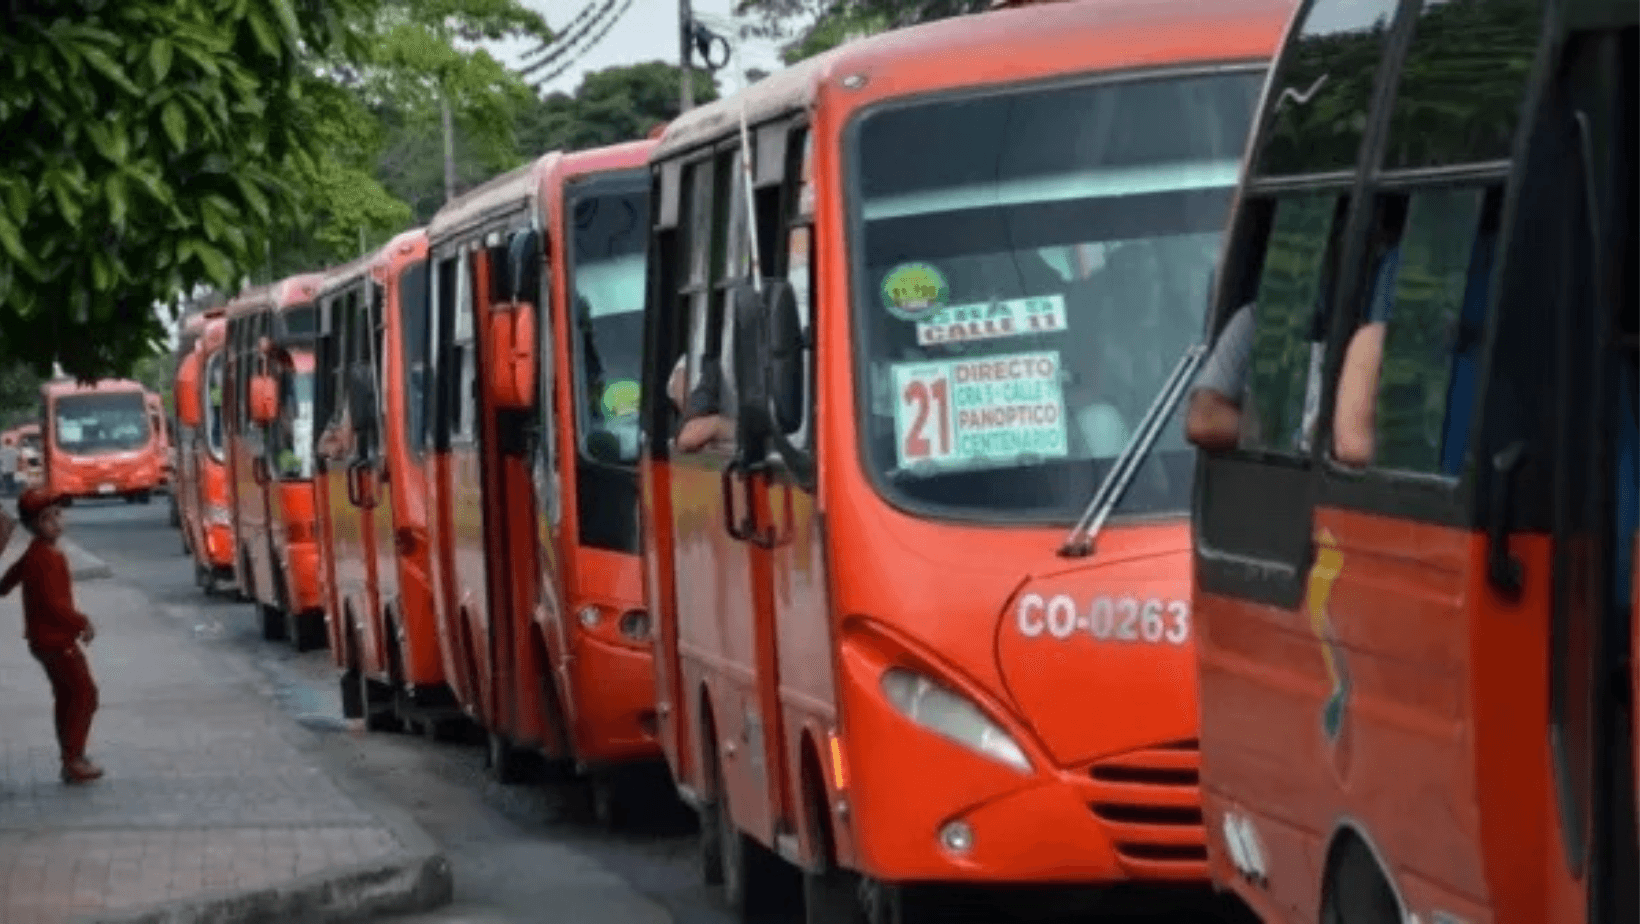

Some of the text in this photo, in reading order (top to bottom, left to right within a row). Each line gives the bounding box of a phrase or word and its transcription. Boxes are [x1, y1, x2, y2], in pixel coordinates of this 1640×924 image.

[924, 317, 1016, 343] CALLE
[955, 358, 1054, 383] DIRECTO
[903, 376, 949, 458] 21
[958, 403, 1058, 430] PANOPTICO
[961, 429, 1060, 455] CENTENARIO
[1018, 593, 1189, 646] CO-0263
